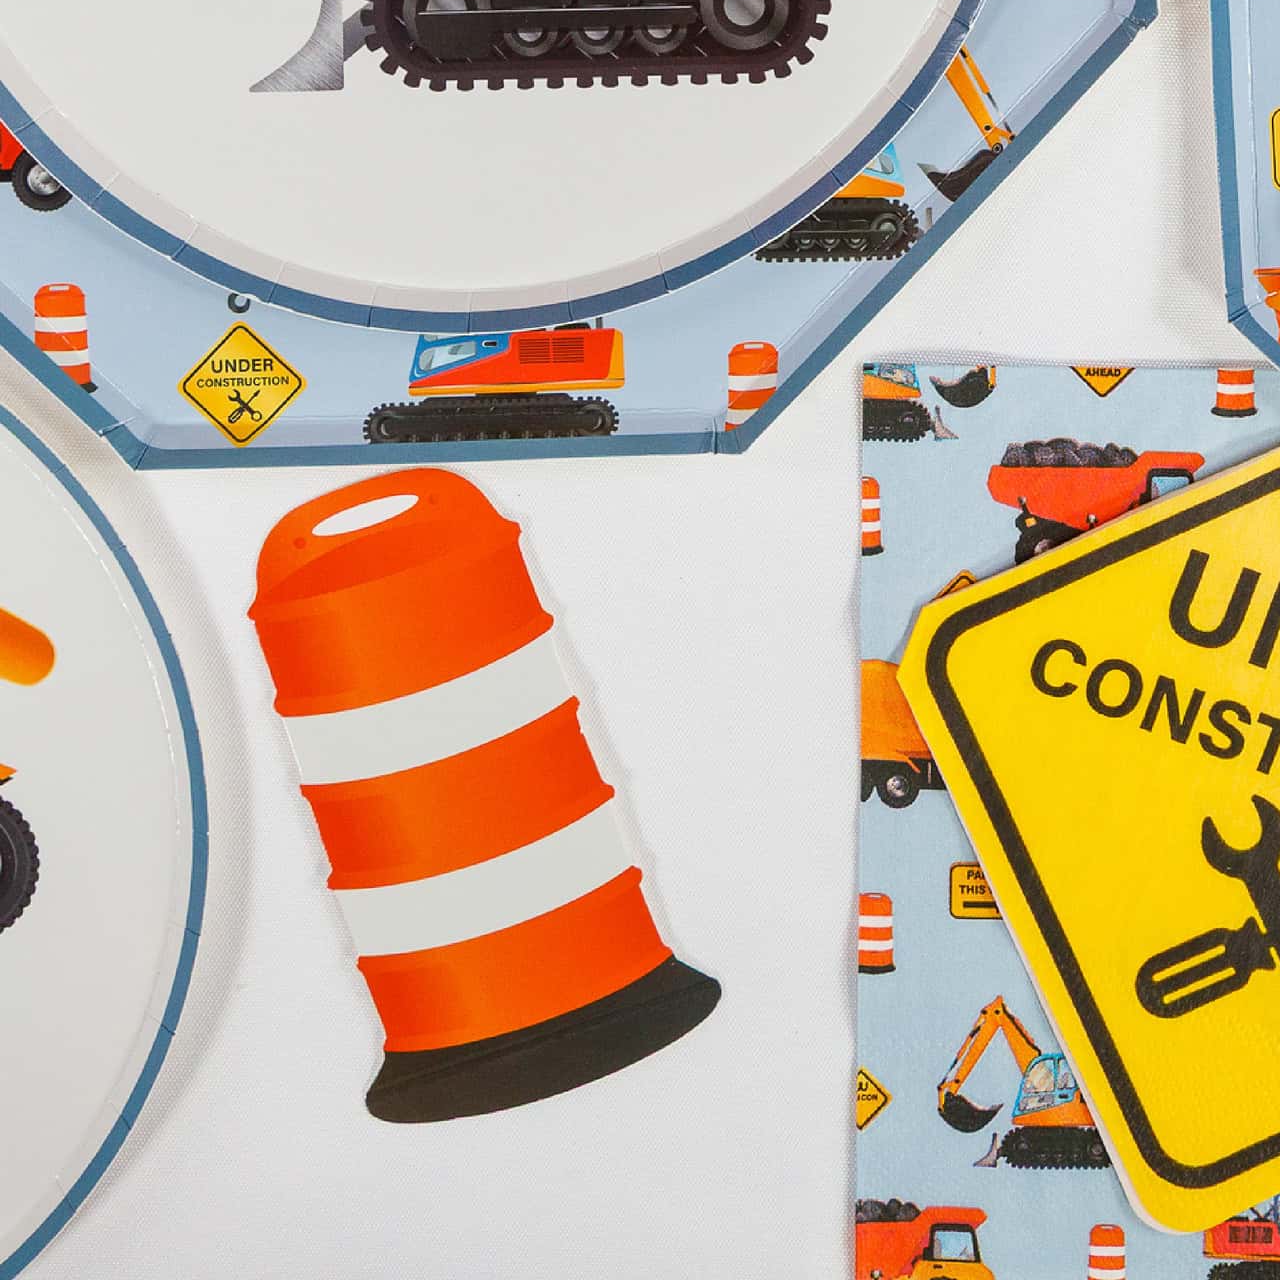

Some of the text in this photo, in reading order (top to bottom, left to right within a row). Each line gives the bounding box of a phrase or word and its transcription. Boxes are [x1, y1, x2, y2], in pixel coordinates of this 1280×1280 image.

[211, 358, 274, 374] UNDER
[1085, 368, 1121, 377] AHEAD
[196, 376, 290, 389] CONSTRUCTION
[959, 884, 986, 895] THIS
